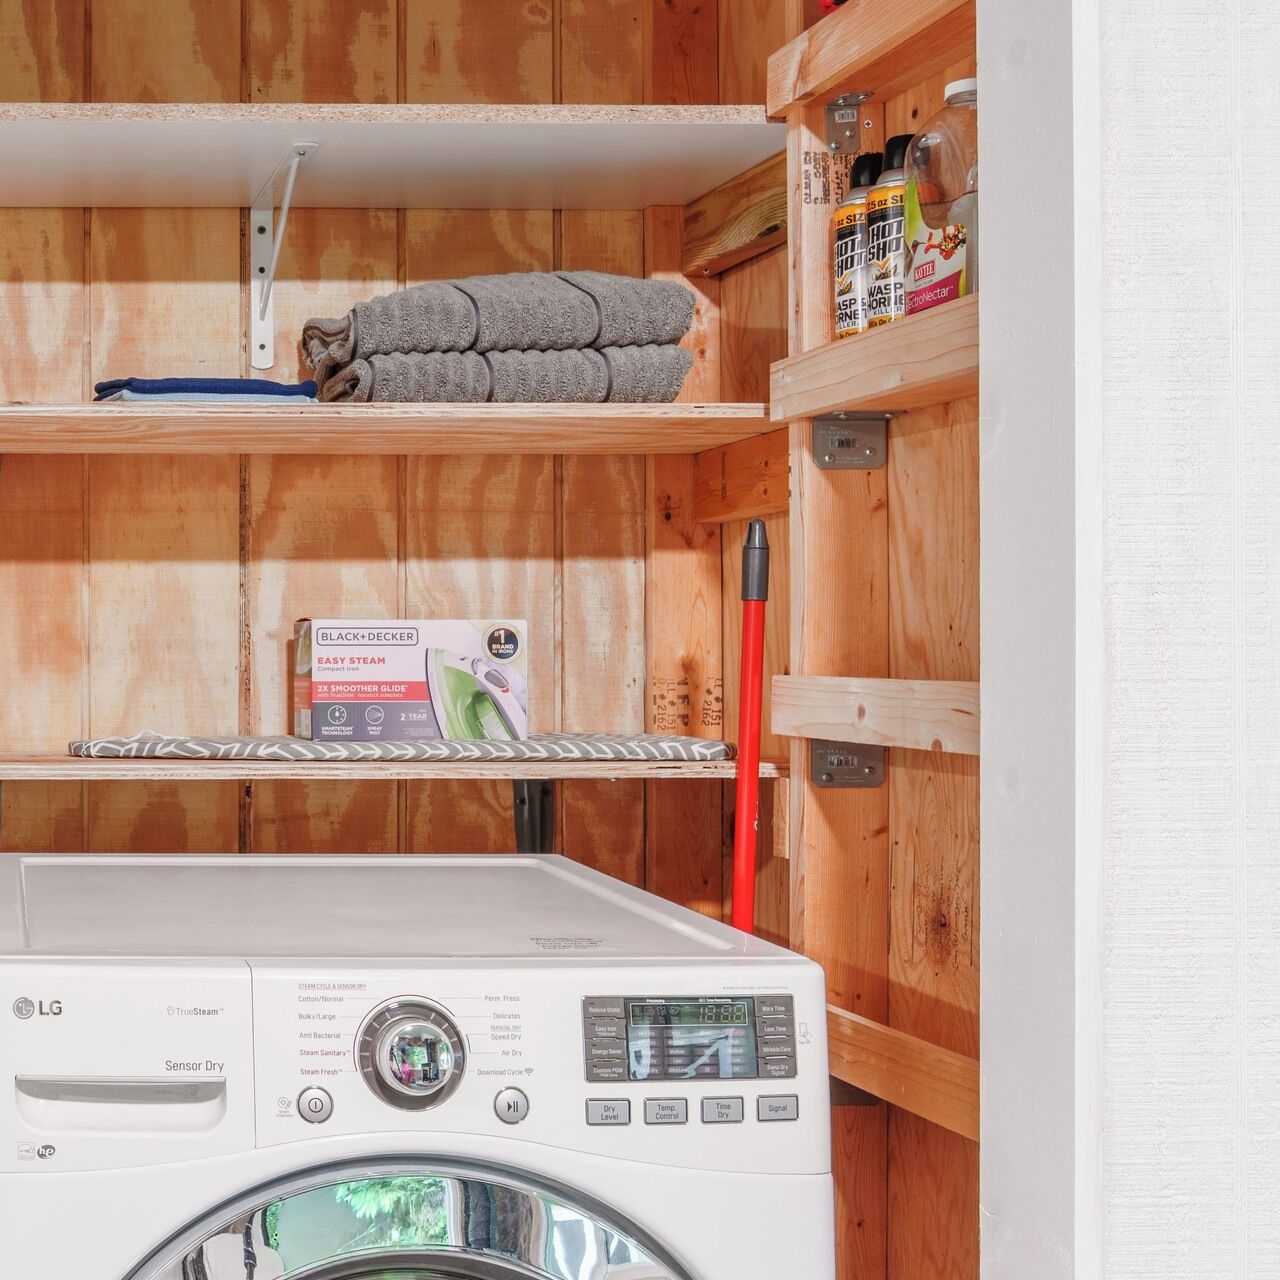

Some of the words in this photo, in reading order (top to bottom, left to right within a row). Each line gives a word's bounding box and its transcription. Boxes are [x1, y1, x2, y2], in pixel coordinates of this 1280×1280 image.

[837, 298, 856, 310] ASP
[321, 632, 414, 641] BLACK+DECKER
[401, 713, 406, 721] 2
[657, 705, 667, 731] 2162
[702, 700, 712, 727] 2162
[38, 1000, 62, 1016] LG
[298, 1013, 336, 1021] Bulky/Large
[165, 1060, 202, 1071] Sensor
[205, 1060, 224, 1073] Dry
[603, 1105, 615, 1113] Dry
[657, 1104, 676, 1113] Temp.
[768, 1104, 787, 1113] Signal
[601, 1112, 619, 1121] Level
[655, 1112, 679, 1120] Control
[717, 1110, 729, 1119] Dry
